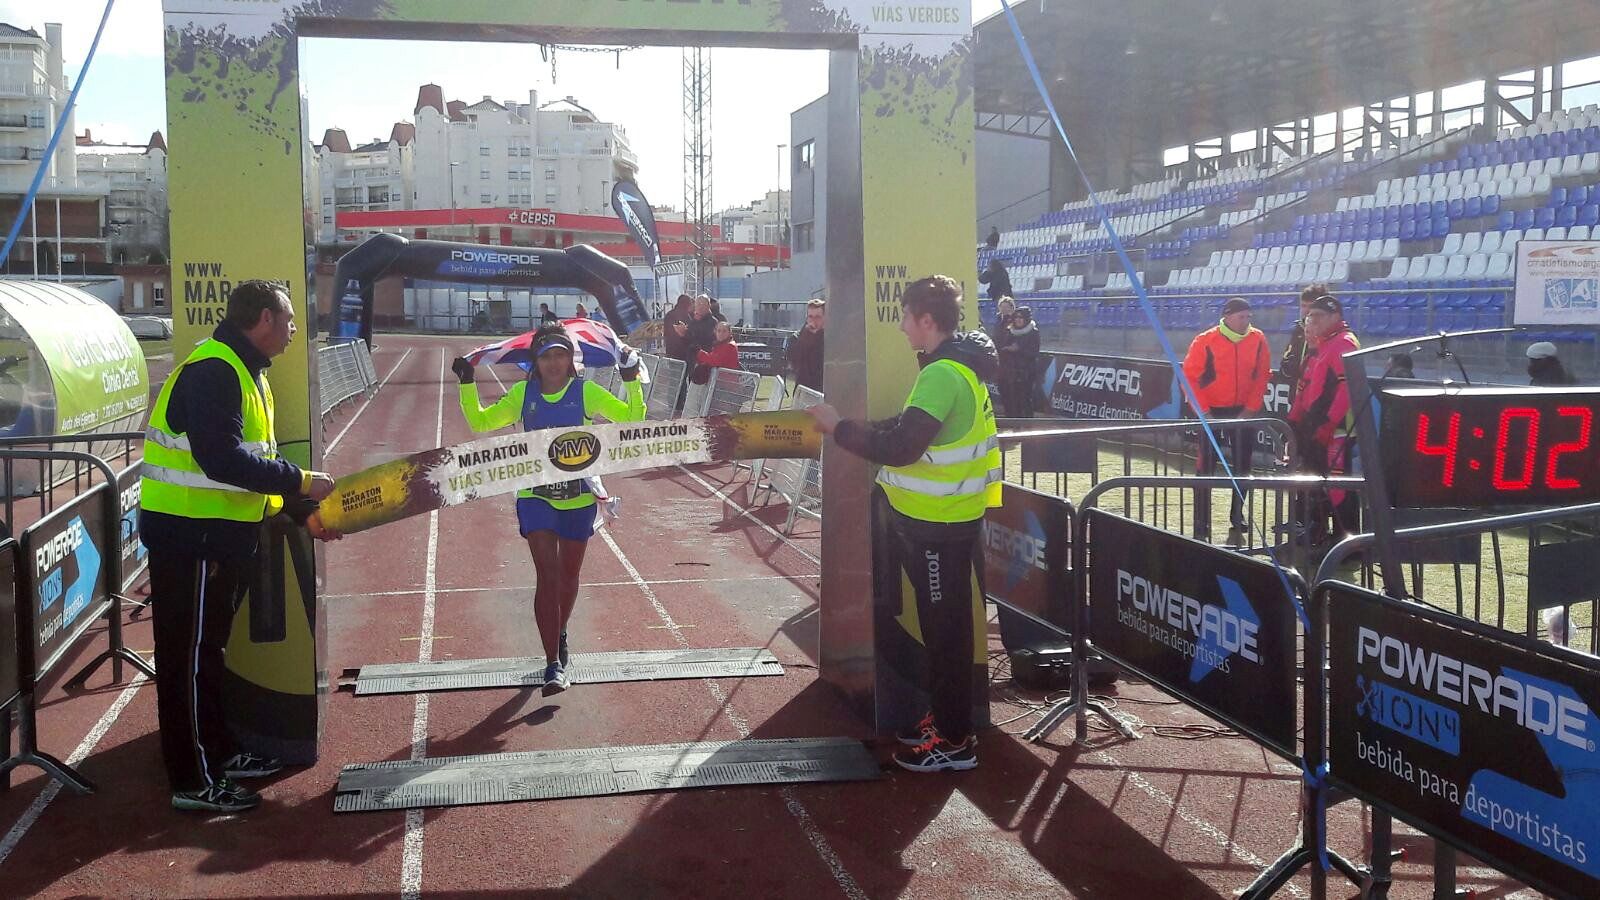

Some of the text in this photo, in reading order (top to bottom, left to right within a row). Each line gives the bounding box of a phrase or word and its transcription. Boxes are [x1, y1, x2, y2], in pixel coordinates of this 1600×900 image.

[908, 7, 960, 23] VERDES
[520, 211, 556, 225] CEPSA
[451, 250, 540, 265] POWERADE
[1058, 363, 1142, 396] POWERAD
[1075, 402, 1097, 418] para
[619, 422, 688, 442] MARATÓN
[646, 438, 700, 456] VERDES
[458, 440, 529, 469] MARATÓN
[1416, 406, 1593, 490] 4:02
[488, 459, 543, 482] VERDES
[36, 519, 83, 578] POWERADE
[925, 550, 942, 603] Joma
[1117, 568, 1260, 664] POWERADE
[1118, 602, 1231, 674] bebida para deportistas
[1357, 626, 1589, 750] POWERADE
[1356, 732, 1588, 865] bebida para deportistas
